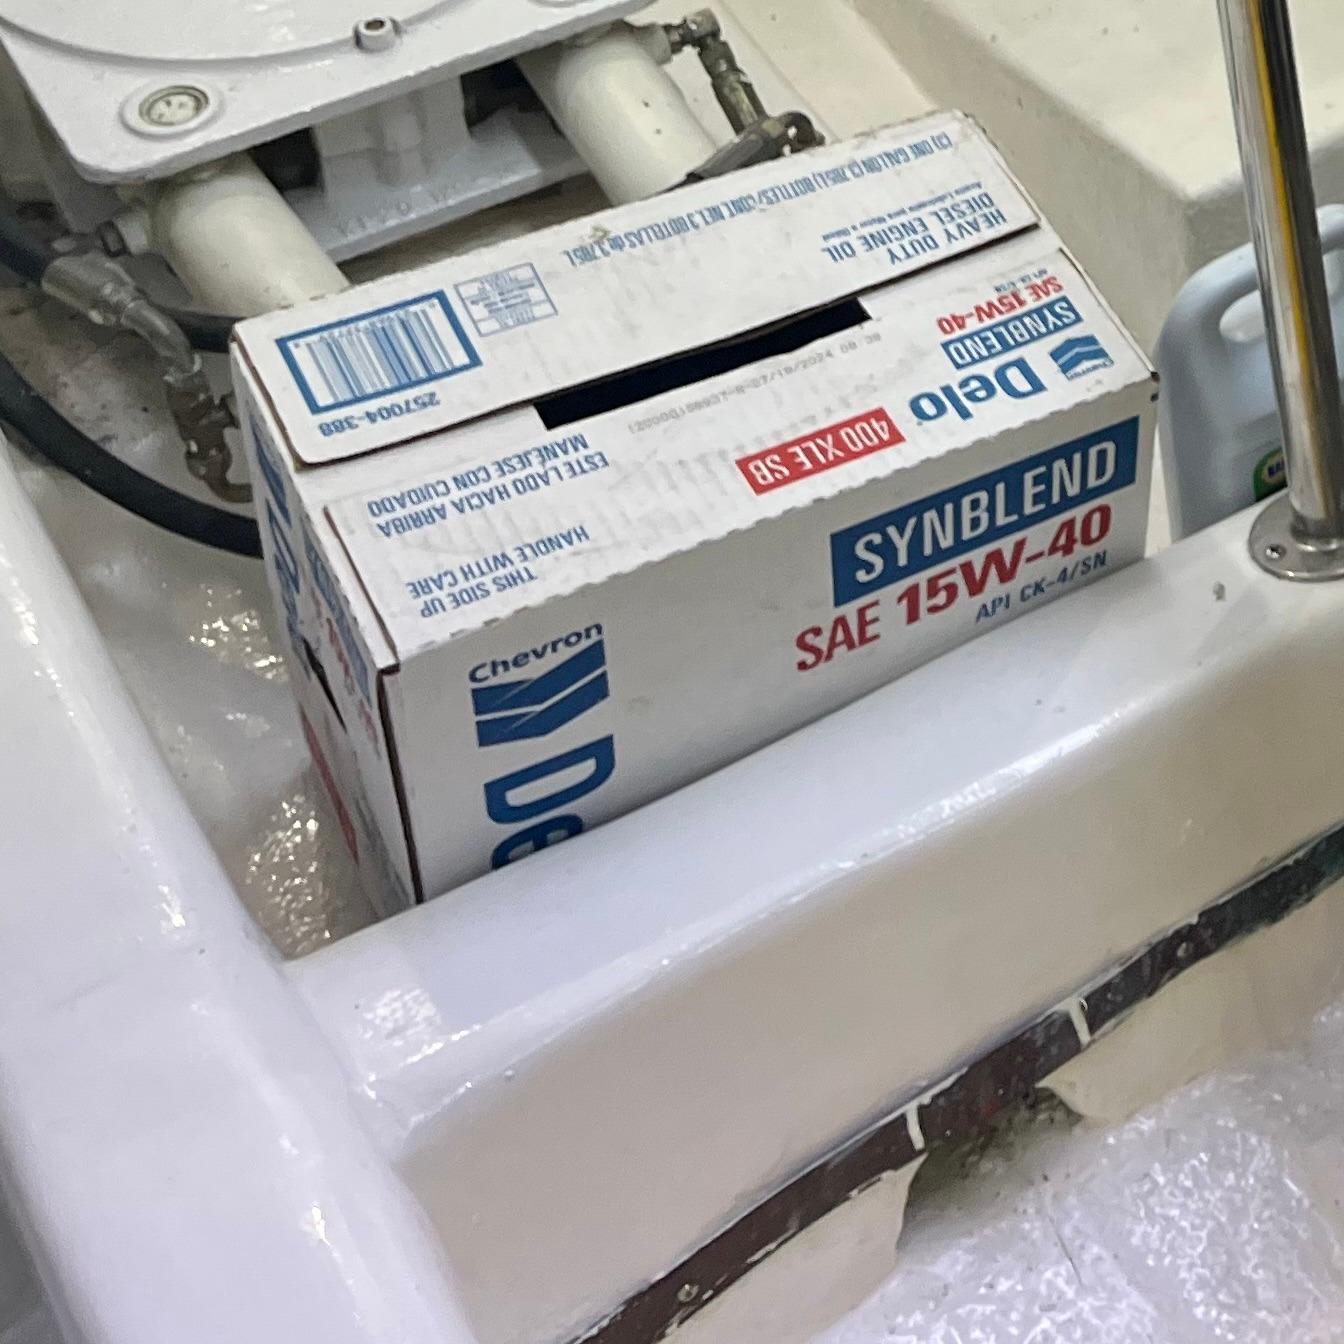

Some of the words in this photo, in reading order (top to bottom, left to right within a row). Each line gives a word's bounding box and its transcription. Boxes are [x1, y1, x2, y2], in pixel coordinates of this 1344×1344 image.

[928, 191, 995, 226] DIESEL
[856, 217, 929, 253] ENGINE
[944, 208, 1008, 244] HEAVY
[821, 240, 857, 264] OIL
[887, 234, 940, 265] DUTY
[1022, 275, 1065, 304] SAE
[936, 288, 1022, 337] 15W-40
[946, 301, 1077, 367] SYNBLEND
[908, 356, 1048, 422] Delo
[845, 416, 891, 452] 400
[566, 451, 610, 480] ESTE
[793, 436, 844, 470] XLE
[451, 465, 491, 491] CON
[512, 466, 564, 496] LADO
[747, 454, 790, 487] SB
[367, 479, 450, 518] CUIDADO
[452, 483, 511, 515] HACIA
[854, 440, 1117, 584] SYNBLEND
[377, 506, 448, 538] ARRIBA
[517, 525, 591, 562] HANDLE
[460, 550, 514, 582] WITH
[491, 566, 538, 593] THIS
[405, 568, 458, 600] CARE
[448, 581, 490, 607] SIDE
[796, 599, 881, 672] SAE
[897, 503, 1113, 626] 15W-40
[975, 591, 1012, 624] API
[1020, 550, 1108, 604] CK-4/SN
[419, 597, 447, 618] UP
[468, 623, 604, 684] Chevron
[483, 733, 616, 871] De
